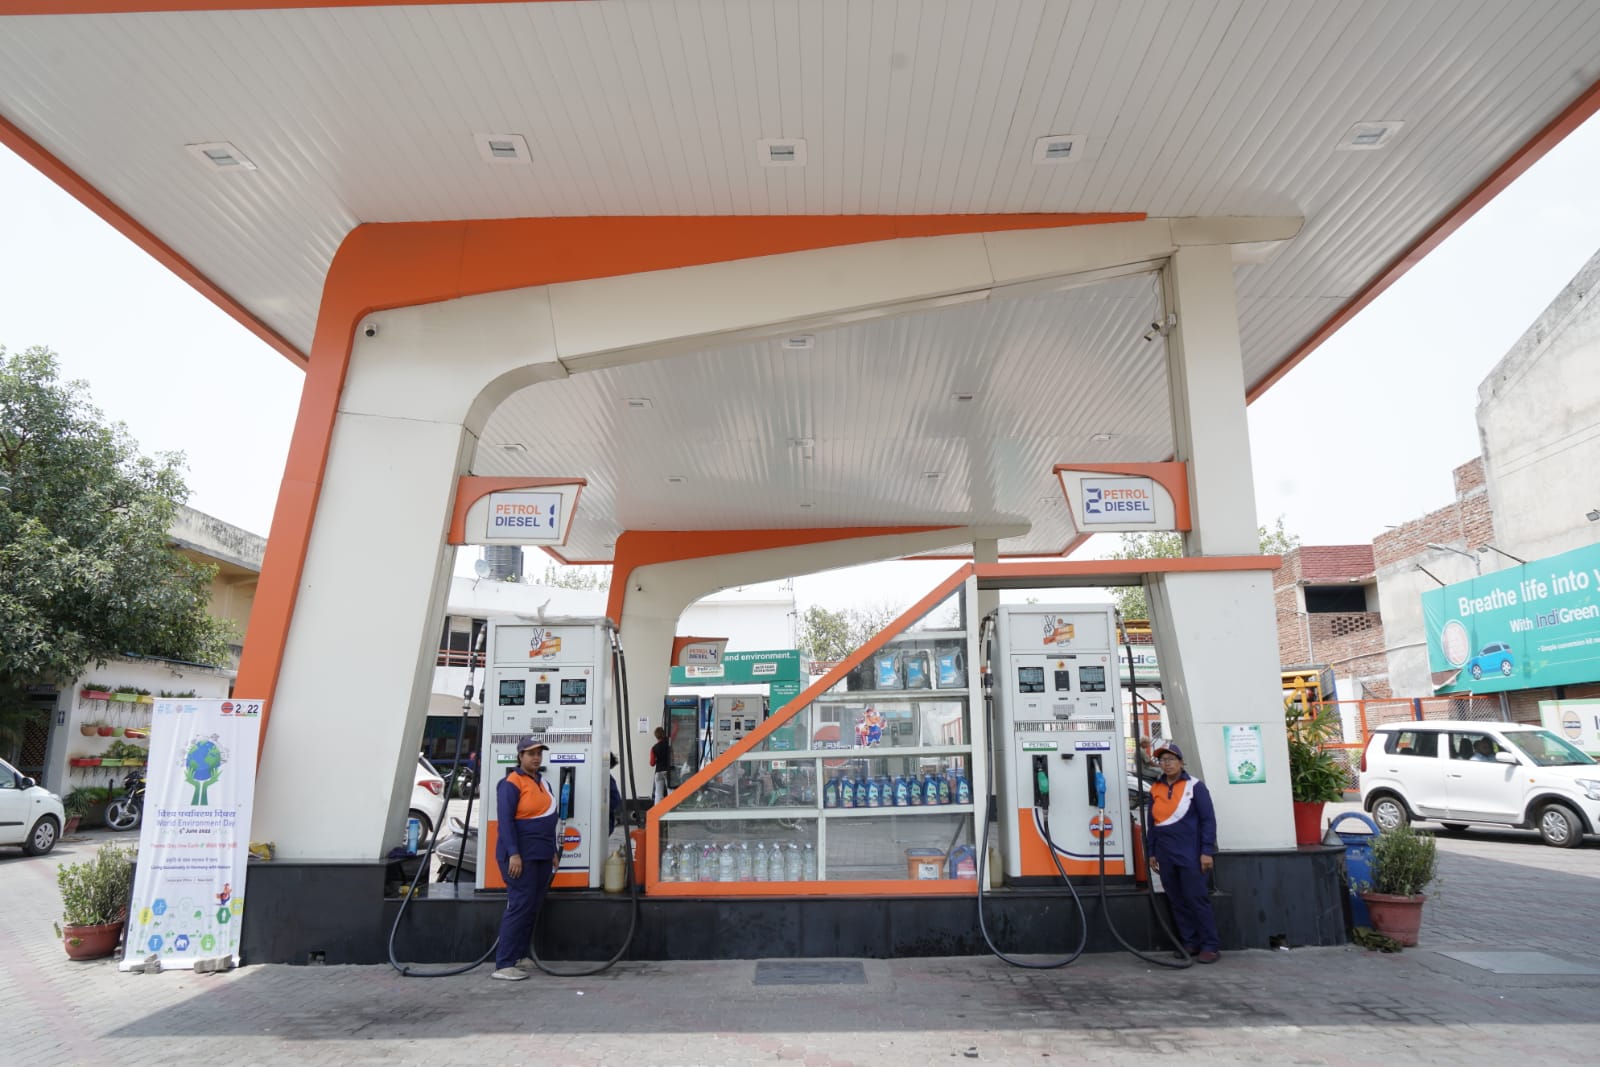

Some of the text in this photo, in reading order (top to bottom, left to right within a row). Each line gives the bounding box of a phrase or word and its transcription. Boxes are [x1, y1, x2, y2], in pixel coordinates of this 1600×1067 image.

[1085, 487, 1102, 513] 2
[1103, 489, 1149, 500] PETROL
[496, 504, 542, 515] PETROL
[1105, 501, 1150, 512] DIESEL
[495, 516, 541, 527] DIESEL
[549, 504, 555, 529] 1
[1458, 588, 1518, 617] Breathe
[1519, 578, 1548, 603] life
[1551, 569, 1590, 596] into
[1509, 604, 1599, 633] With IndiGreen
[709, 650, 717, 660] 4
[725, 654, 740, 662] and
